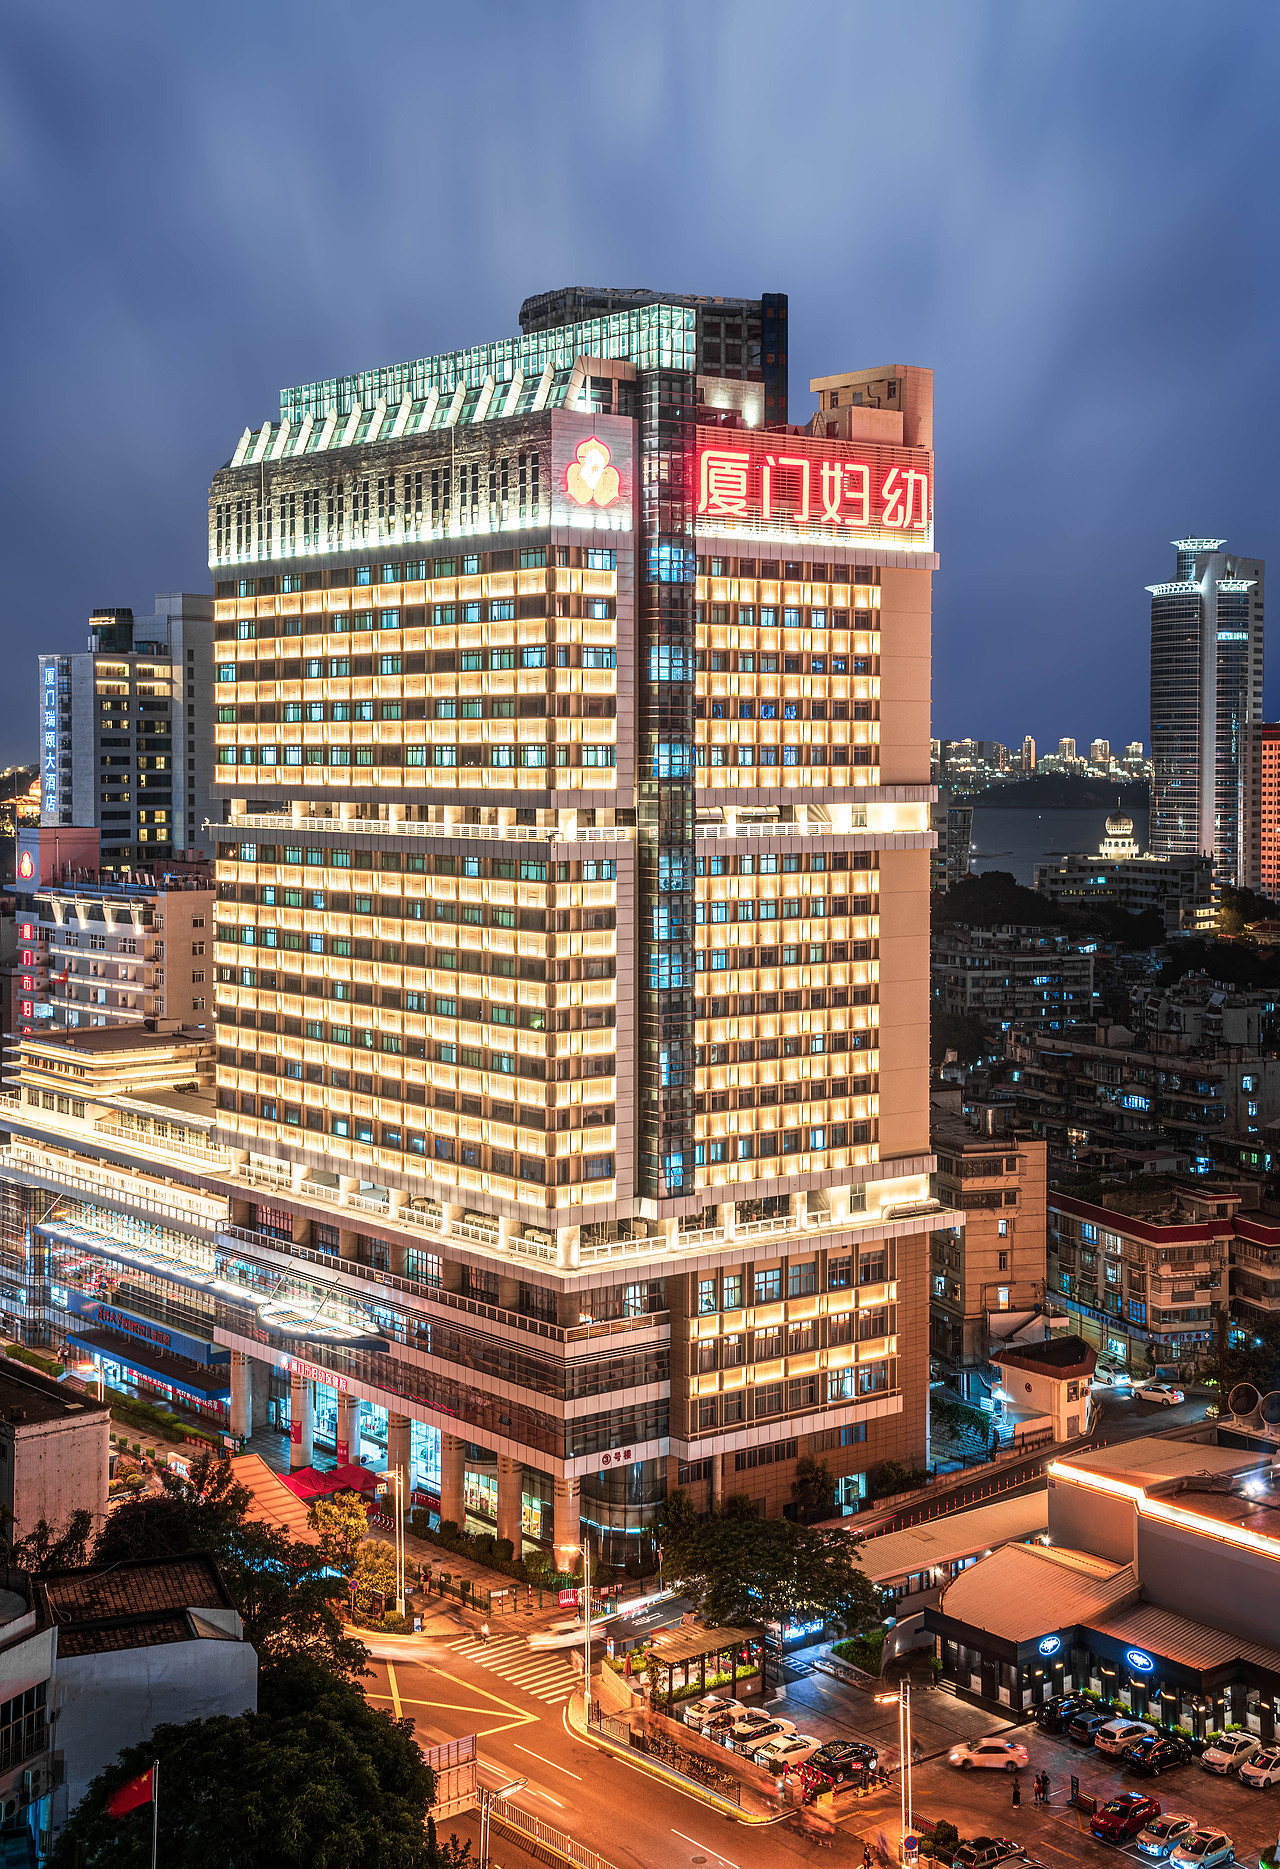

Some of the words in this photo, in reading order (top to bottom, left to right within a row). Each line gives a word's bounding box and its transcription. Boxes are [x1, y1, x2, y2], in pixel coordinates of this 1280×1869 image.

[698, 450, 928, 528] 厦门妇幼
[44, 667, 56, 812] 厦门瑞颐大酒店
[291, 1359, 347, 1391] 厦门市妇幼保健院
